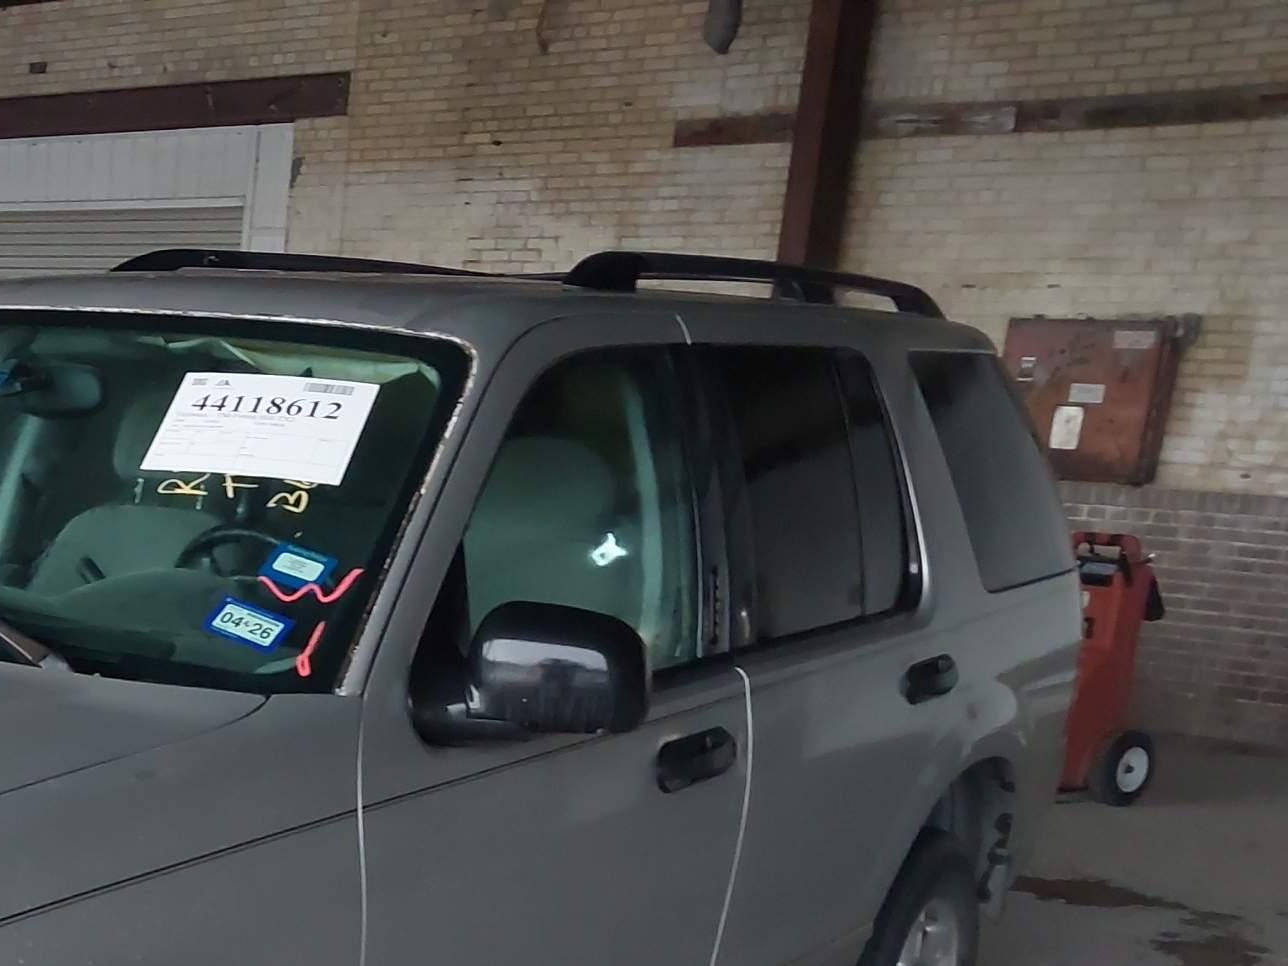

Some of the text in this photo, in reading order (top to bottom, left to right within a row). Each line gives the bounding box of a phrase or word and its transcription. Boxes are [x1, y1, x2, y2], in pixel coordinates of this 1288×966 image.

[191, 394, 343, 420] 44118612
[220, 612, 245, 628] 04
[247, 623, 274, 640] 26
